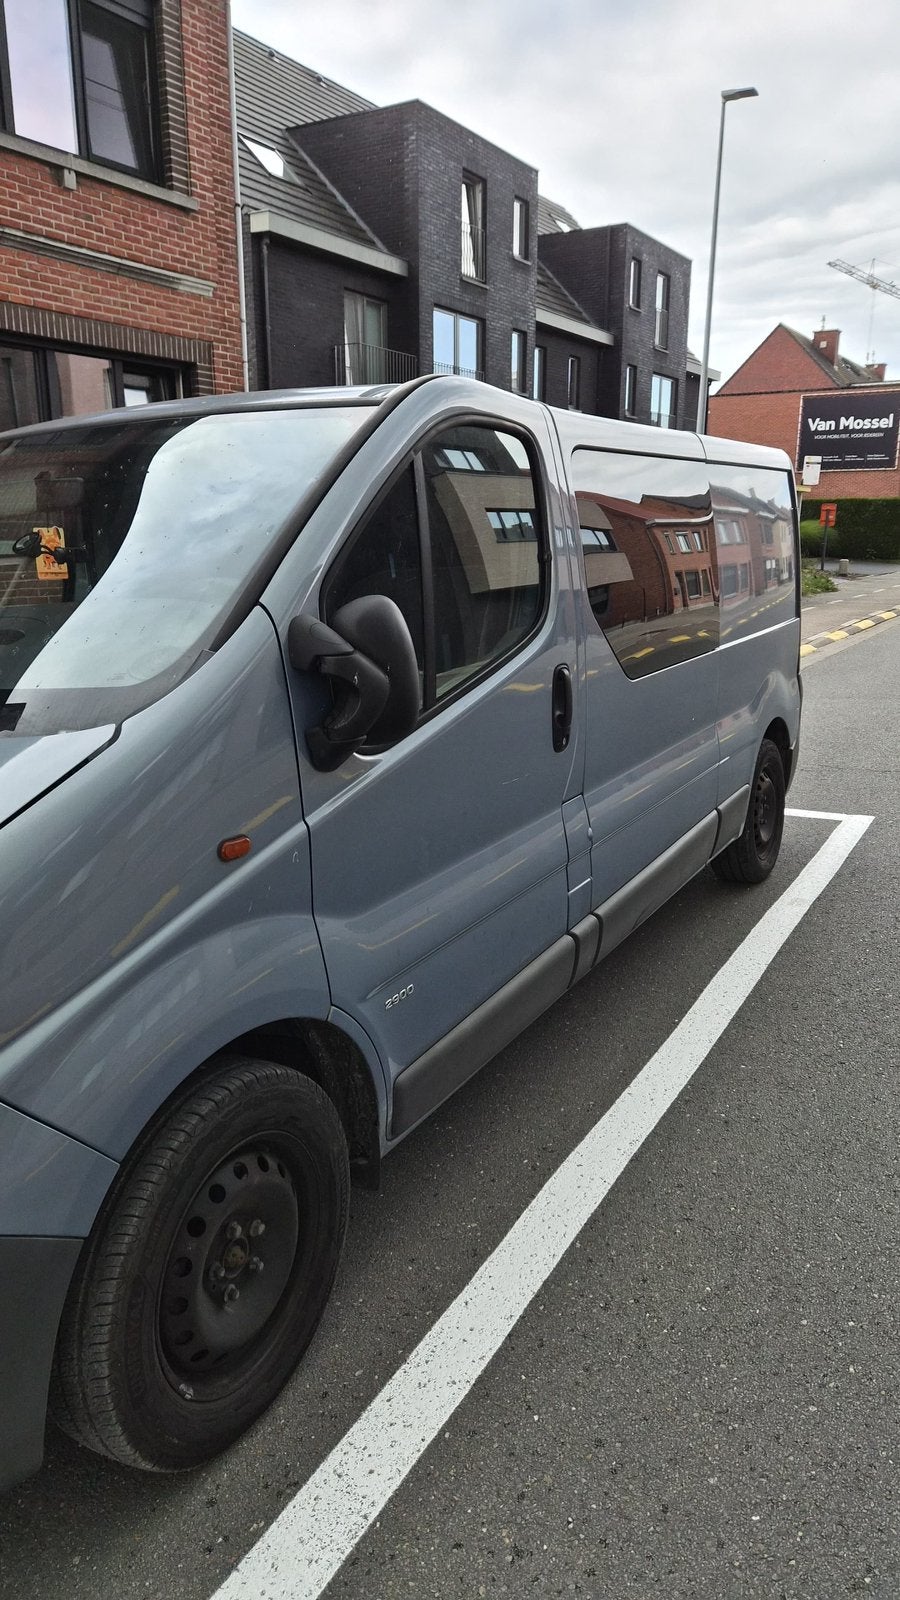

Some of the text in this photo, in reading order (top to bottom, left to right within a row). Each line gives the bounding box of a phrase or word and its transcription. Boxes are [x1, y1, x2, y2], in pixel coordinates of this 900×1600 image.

[807, 413, 894, 431] Van Mossel
[385, 983, 414, 1010] 2900
